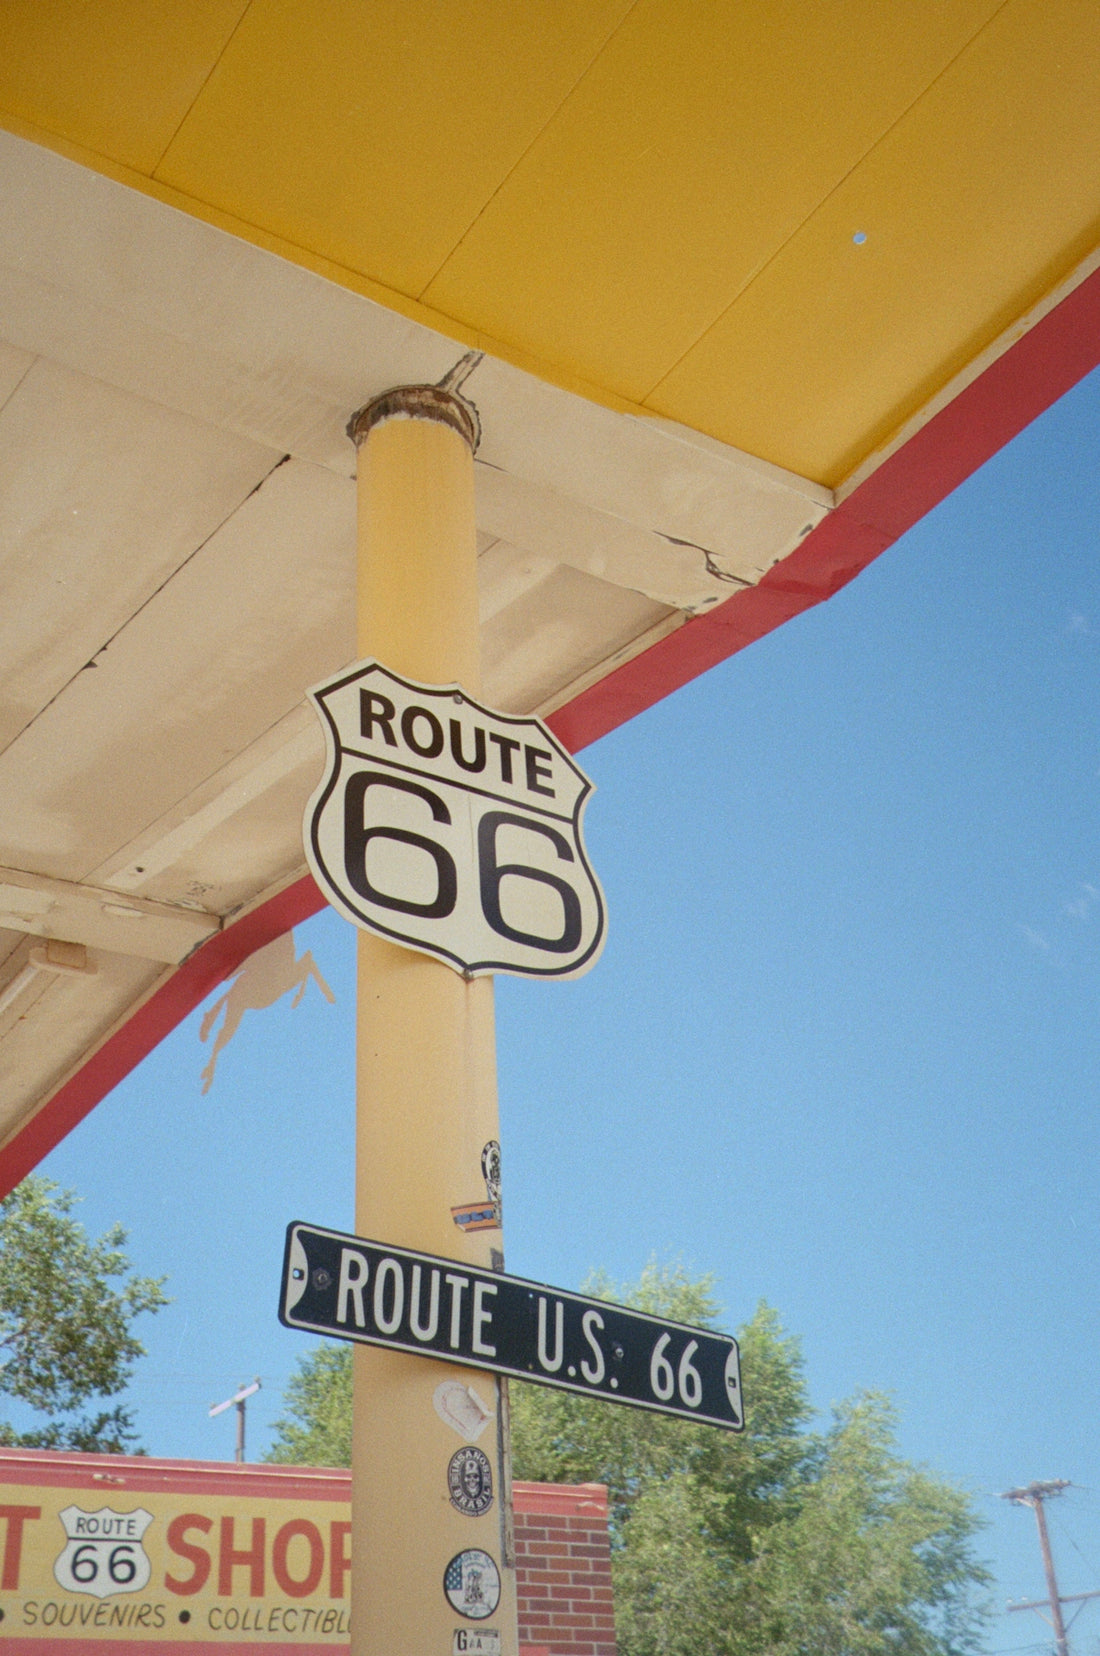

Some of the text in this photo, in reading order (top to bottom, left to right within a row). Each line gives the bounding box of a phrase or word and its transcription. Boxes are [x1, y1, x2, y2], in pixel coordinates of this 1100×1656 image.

[359, 687, 556, 799] ROUTE
[344, 770, 582, 954] 66
[336, 1247, 703, 1408] ROUTE U.S. 66
[451, 1450, 490, 1474] INSANOS
[453, 1488, 491, 1509] BRASIL
[75, 1516, 137, 1536] ROUTE
[70, 1545, 137, 1585] 66
[22, 1601, 351, 1635] SOUVENIRS COLLECTIBL
